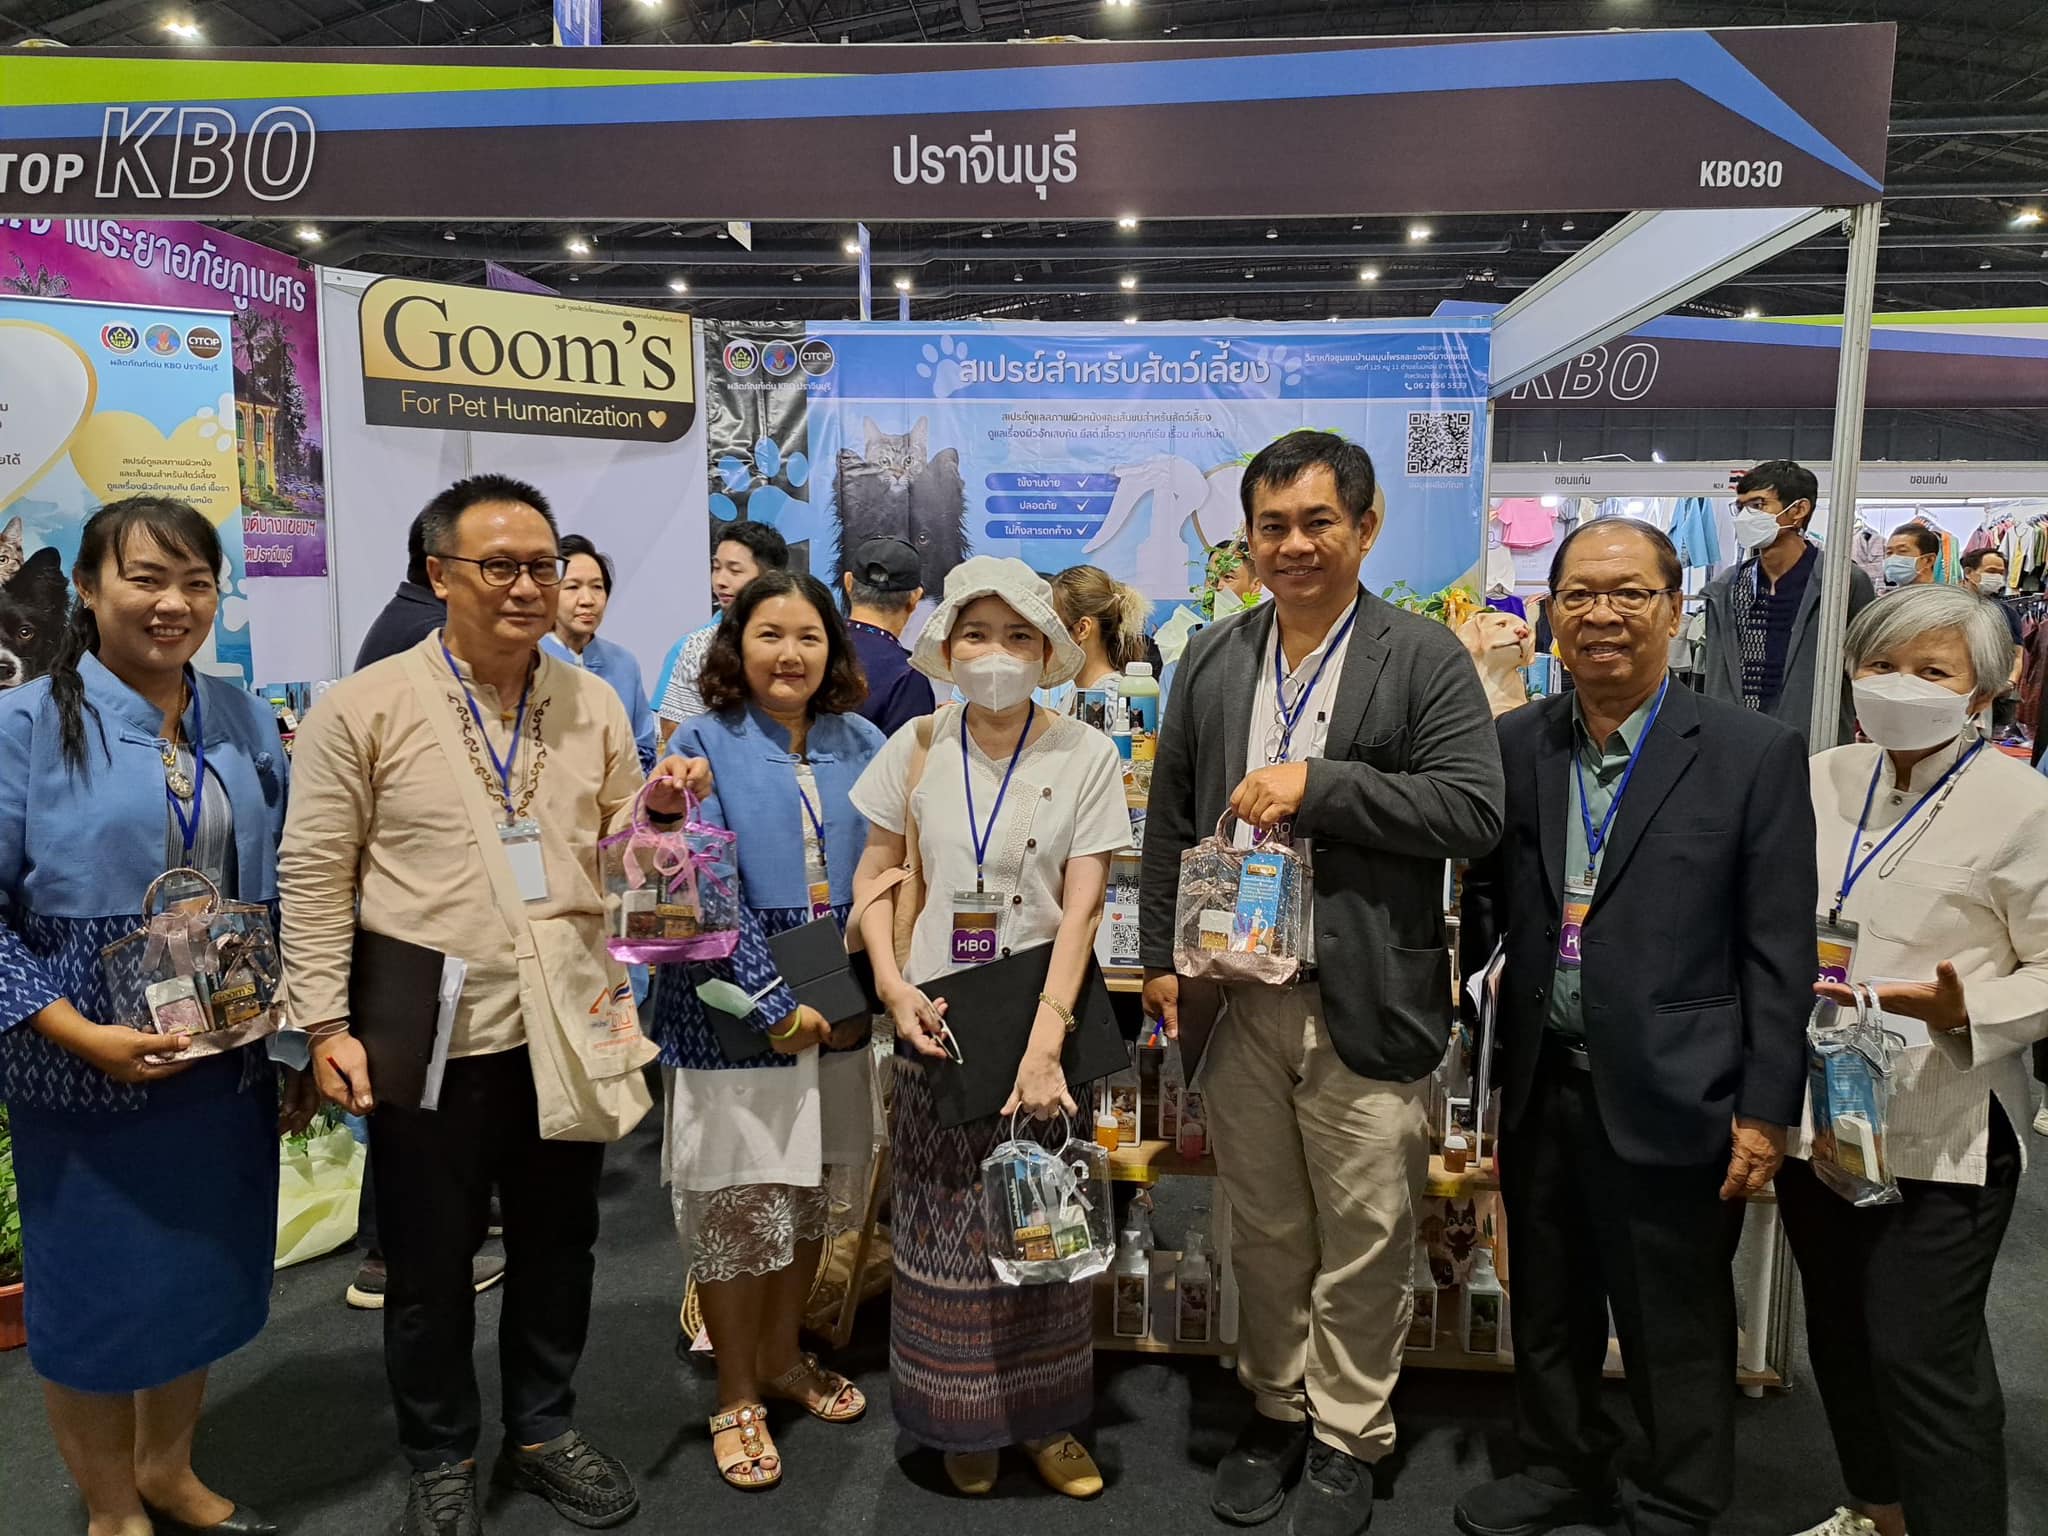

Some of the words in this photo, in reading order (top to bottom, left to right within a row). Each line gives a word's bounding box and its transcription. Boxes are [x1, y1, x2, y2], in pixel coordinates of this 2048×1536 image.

[95, 106, 316, 201] KBO
[892, 128, 1078, 201] ปราจีนบุรี
[1699, 160, 1783, 188] KBO30
[188, 336, 220, 347] OTOP
[383, 295, 677, 392] Goom's
[802, 352, 832, 361] OTOP
[958, 340, 1272, 385] สเปรย์สำหรับสัตว์เลี้ยง
[401, 389, 441, 415] For
[448, 393, 488, 418] Pet
[493, 396, 642, 428] Humanization
[1554, 473, 1592, 486] ขอนแก่น
[1909, 473, 1948, 486] ขอนแก่น
[1019, 499, 1058, 511] ปลอดภัย
[1004, 521, 1073, 536] ไม่ทิ้งสารตกค้าง
[957, 939, 991, 952] KBO
